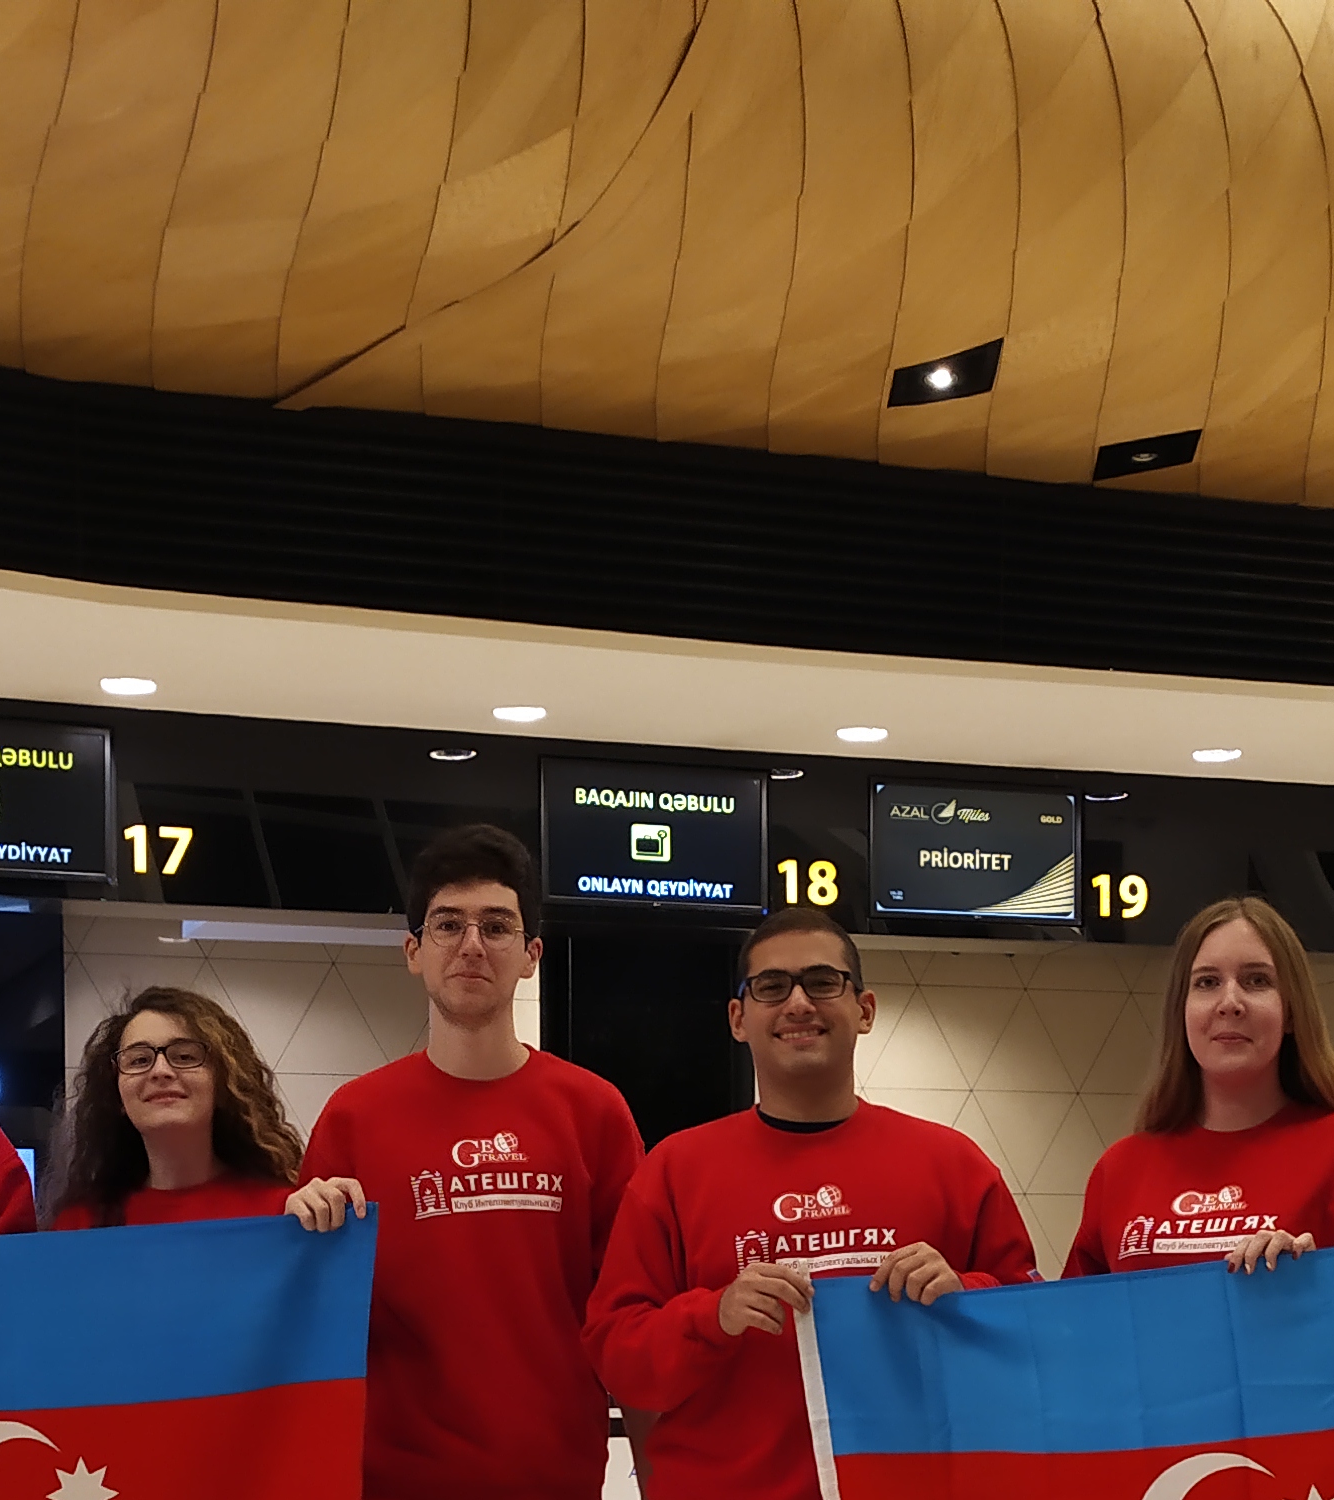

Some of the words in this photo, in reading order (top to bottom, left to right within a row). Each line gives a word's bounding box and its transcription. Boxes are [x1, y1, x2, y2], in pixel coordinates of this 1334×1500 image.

[575, 787, 654, 809] BAQAJIN
[659, 792, 736, 814] QƏBULU
[889, 804, 930, 820] AZAL
[957, 808, 991, 823] Miles
[1039, 815, 1063, 824] GOLD
[123, 824, 193, 875] 17
[578, 876, 644, 895] ONLAYN
[647, 878, 734, 898] QEYDİYYAT
[777, 858, 839, 907] 18
[1092, 873, 1149, 919] 19
[478, 1152, 527, 1163] TRAVEL
[450, 1172, 563, 1194] АТЕШГЯХ
[1155, 1215, 1279, 1235] АТЕШГЯХ
[775, 1228, 897, 1254] АТЕШГЯХ
[1156, 1240, 1177, 1252] Клуб
